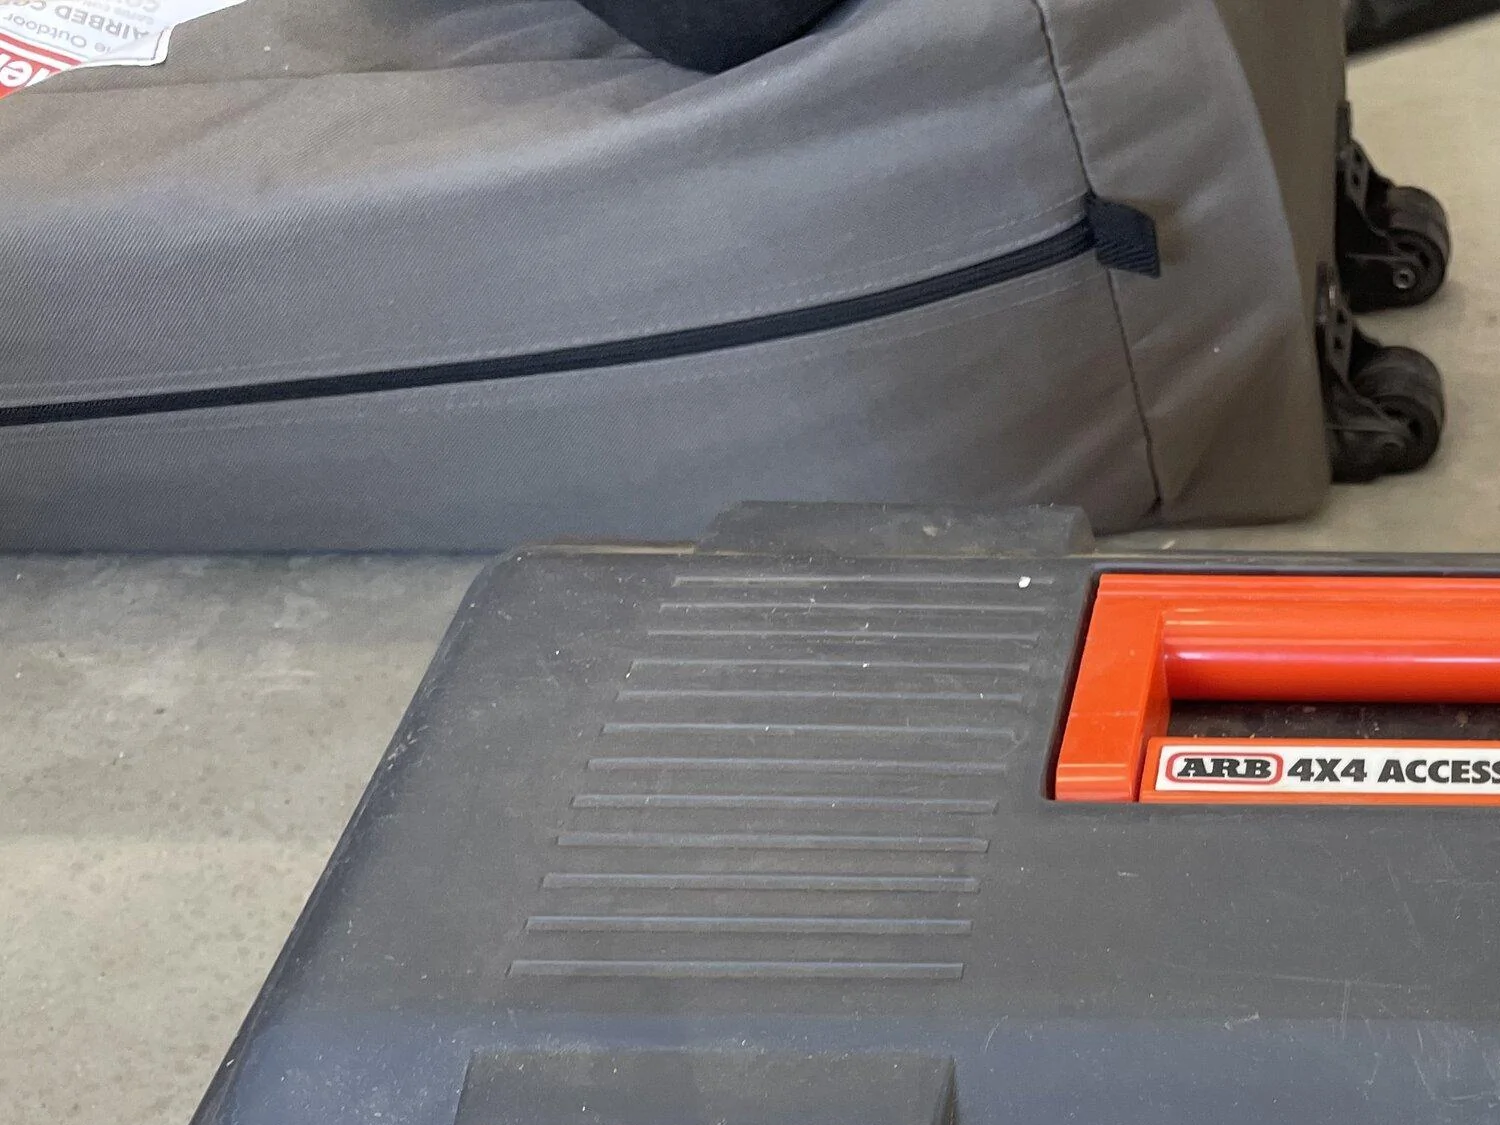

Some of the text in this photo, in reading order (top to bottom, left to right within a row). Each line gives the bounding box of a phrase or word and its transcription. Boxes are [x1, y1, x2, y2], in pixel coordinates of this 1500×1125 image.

[3, 13, 86, 48] Outdoor
[54, 5, 149, 40] AIRBED
[1177, 758, 1272, 778] ARB
[1287, 759, 1367, 783] 4X4
